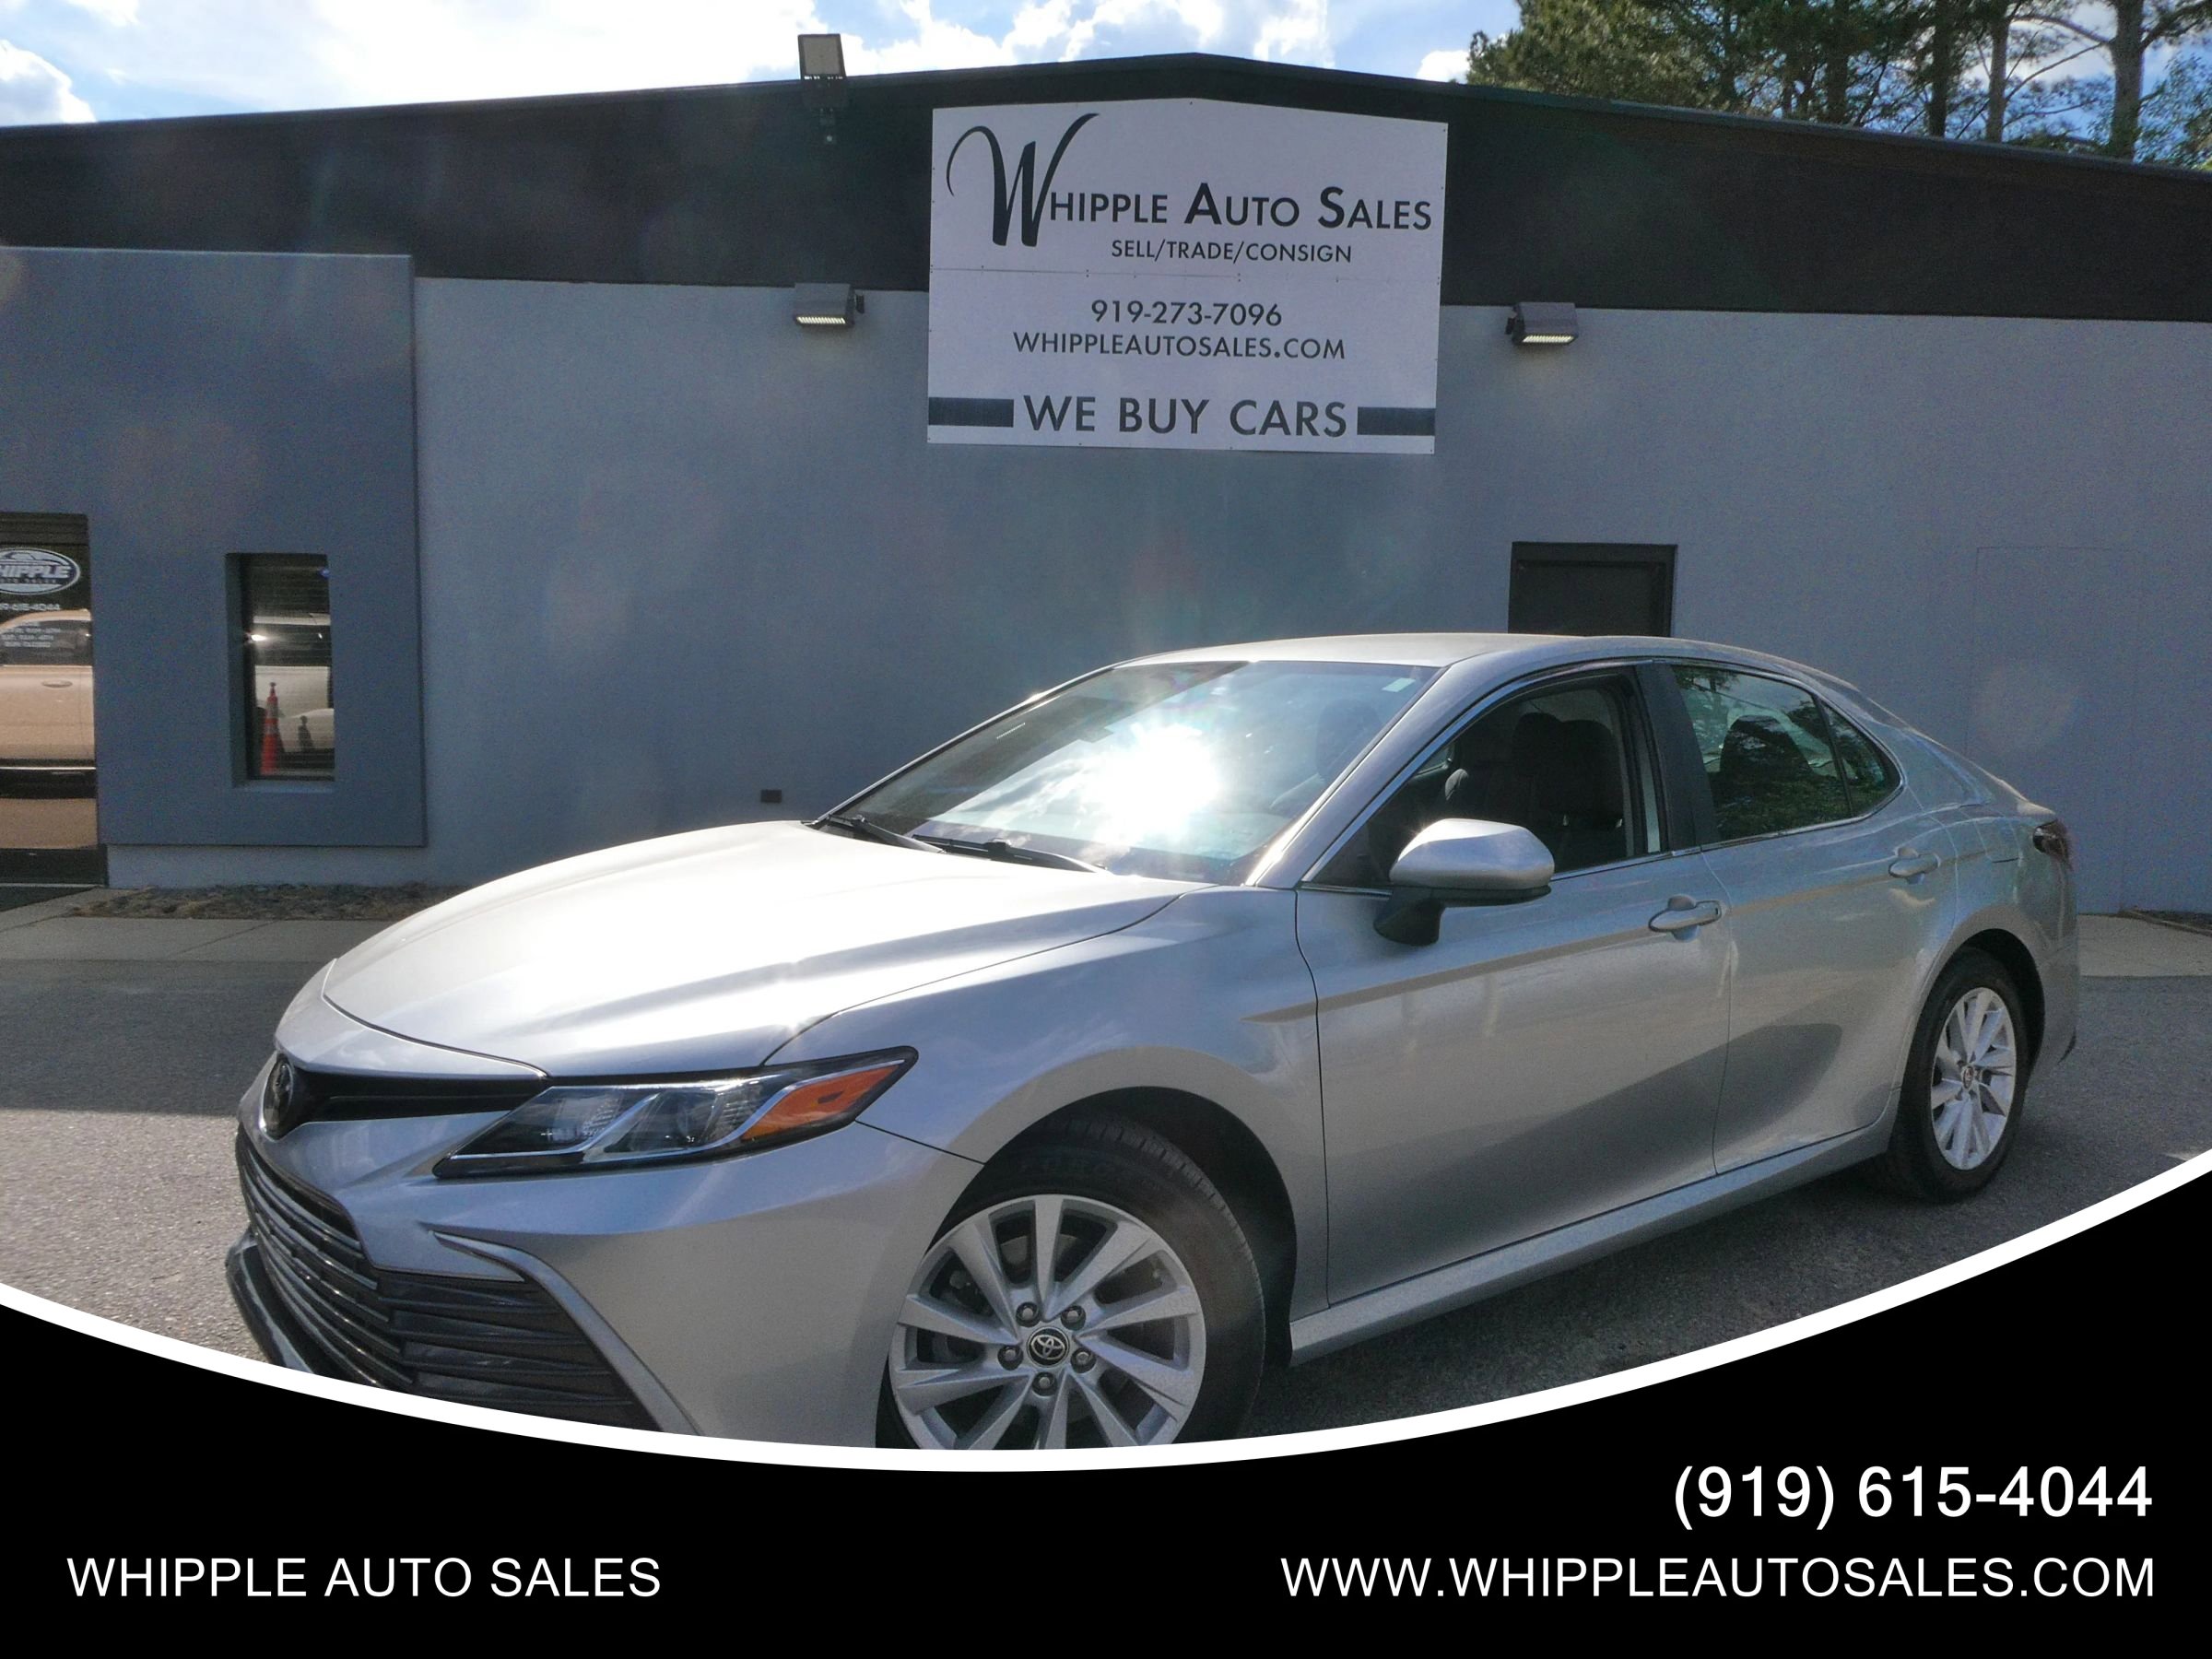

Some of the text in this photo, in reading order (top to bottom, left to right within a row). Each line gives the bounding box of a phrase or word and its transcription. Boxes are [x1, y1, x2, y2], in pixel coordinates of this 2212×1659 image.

[946, 112, 1432, 248] WHIPPLE AUTO SALES
[1112, 240, 1352, 264] SELL/TRADE/CONSIGN
[1091, 299, 1282, 327] 919-273-7096
[1013, 331, 1346, 360] WHIPPLEAUTOSALES.COM
[1023, 395, 1347, 438] WE BUY CARS
[0, 564, 71, 579] HIPPLE
